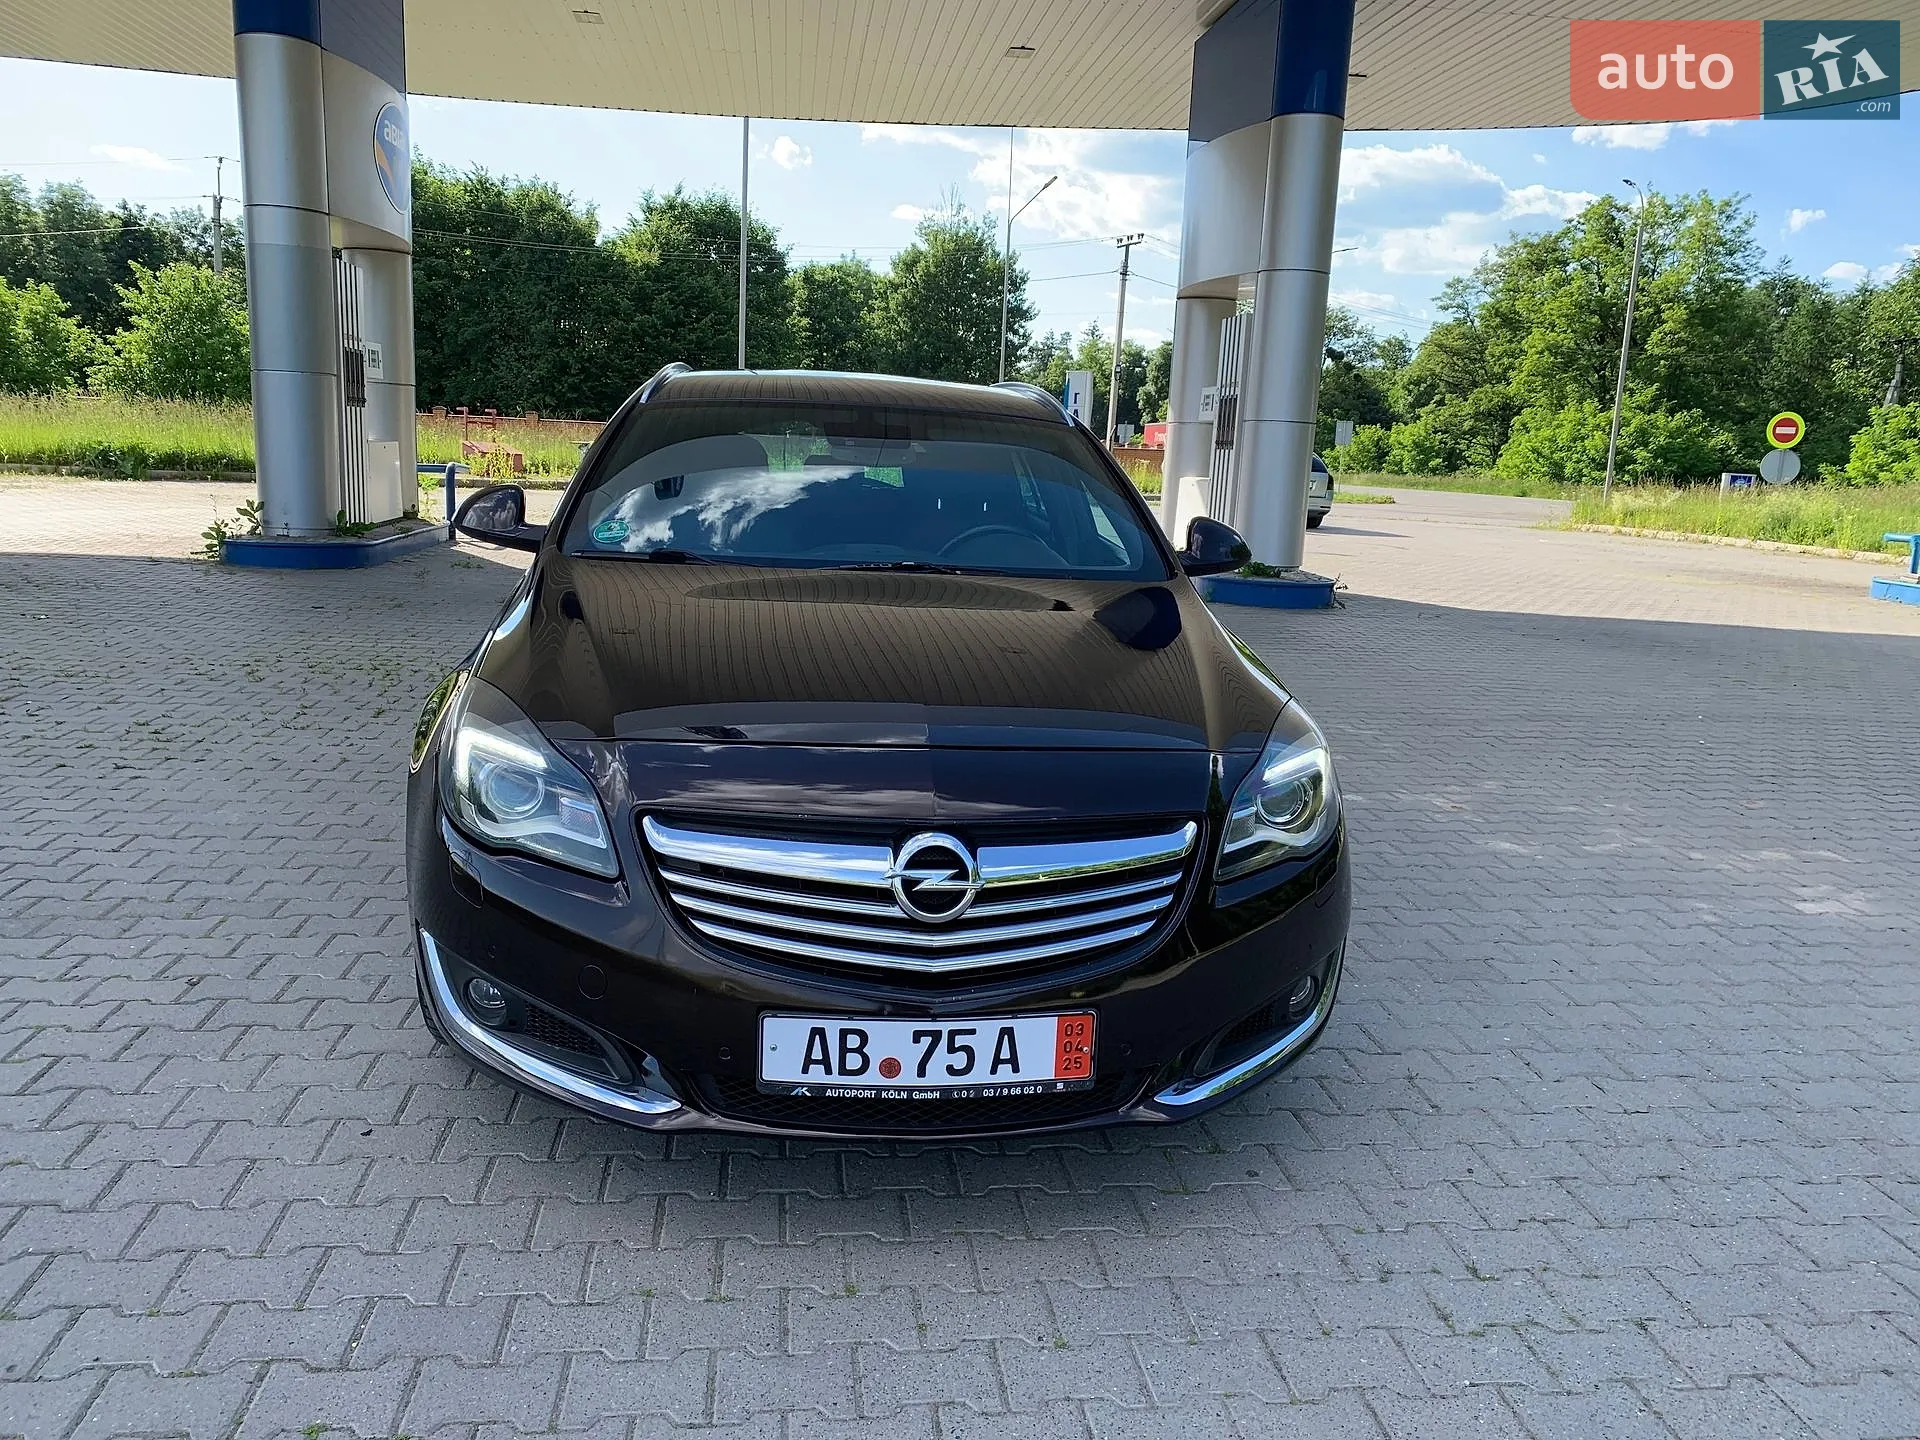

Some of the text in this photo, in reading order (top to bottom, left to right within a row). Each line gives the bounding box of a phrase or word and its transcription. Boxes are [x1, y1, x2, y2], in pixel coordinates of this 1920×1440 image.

[1064, 1022, 1084, 1037] 03
[801, 1026, 1021, 1078] AB 75 A
[1063, 1039, 1083, 1053] 04
[1062, 1056, 1082, 1071] 25
[825, 1088, 876, 1098] AUTOPORT
[881, 1089, 907, 1099] KÖLN
[912, 1090, 940, 1099] GmbH
